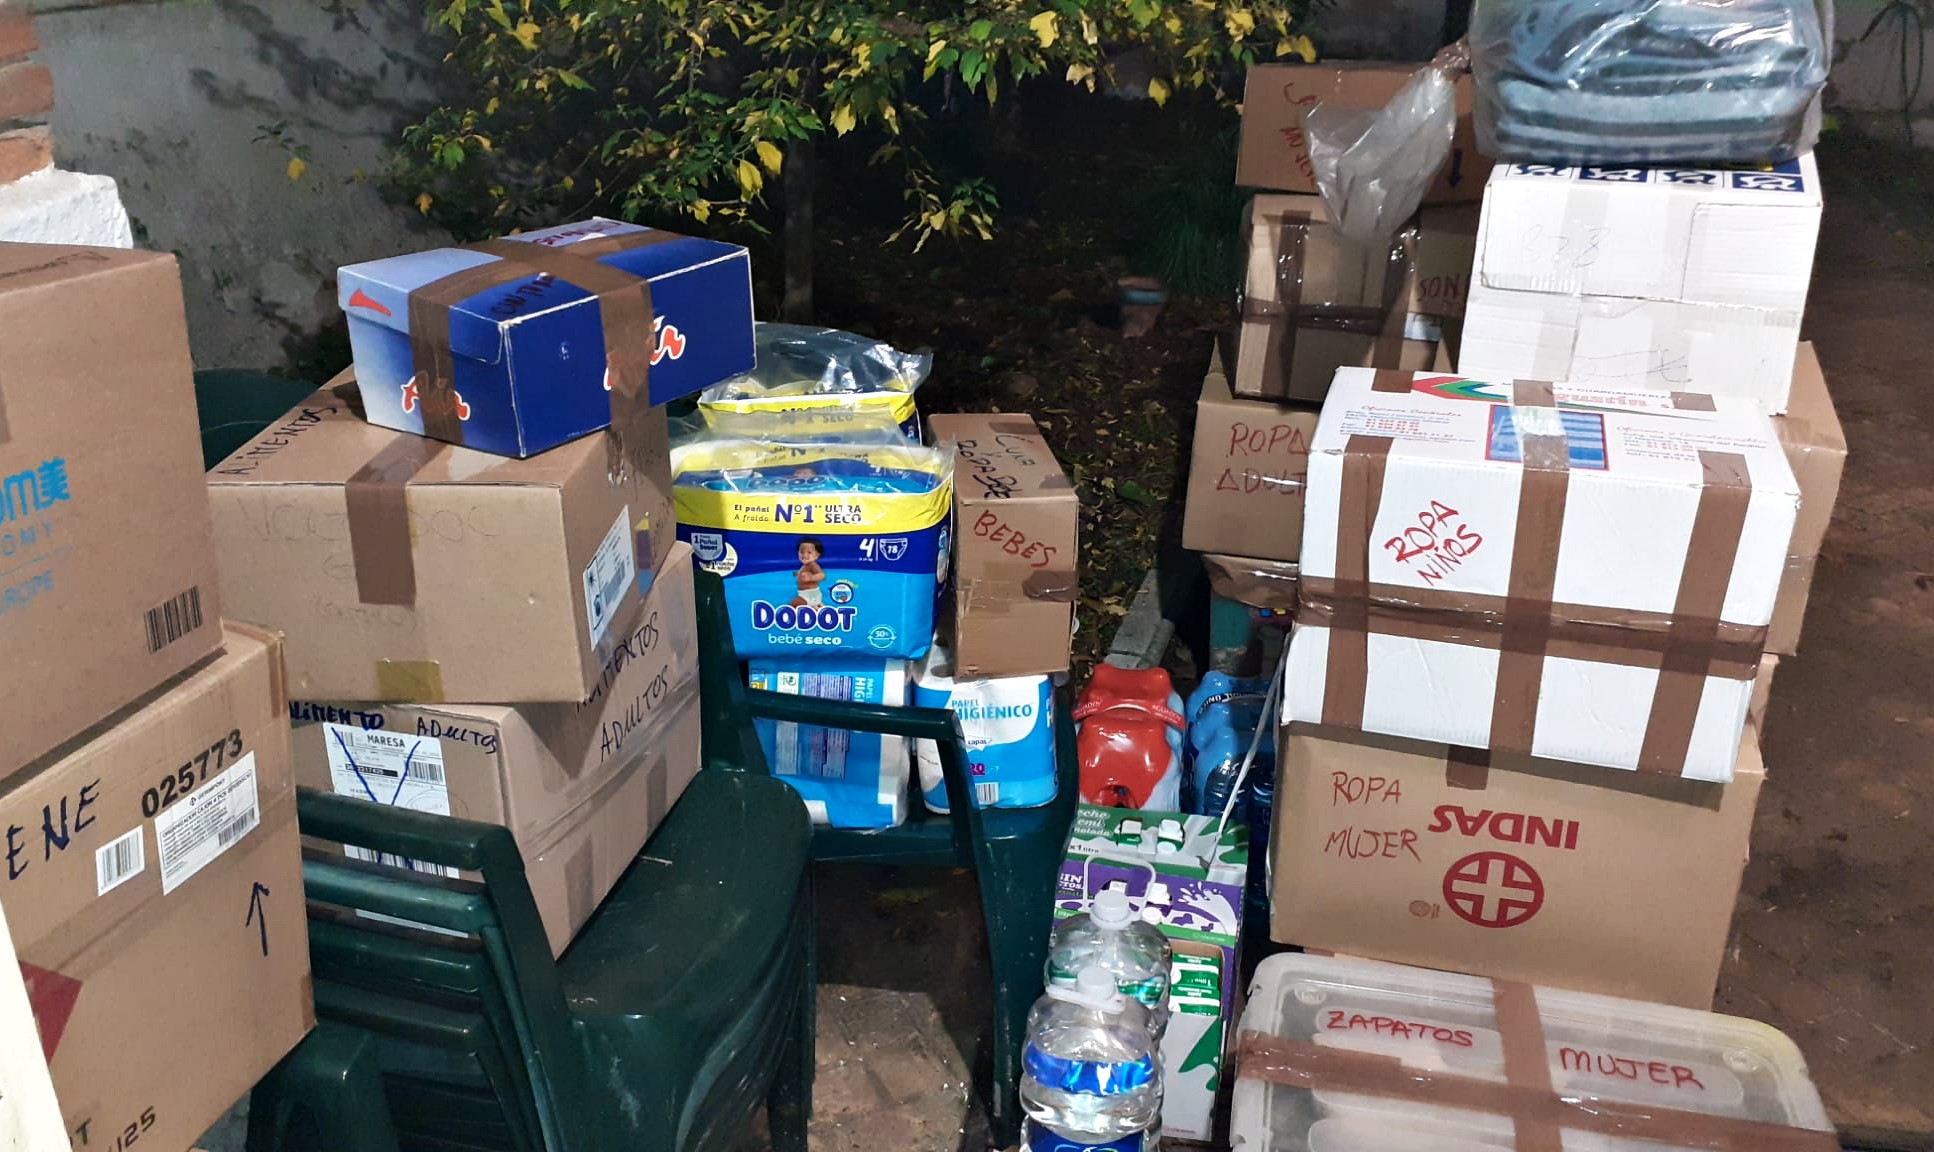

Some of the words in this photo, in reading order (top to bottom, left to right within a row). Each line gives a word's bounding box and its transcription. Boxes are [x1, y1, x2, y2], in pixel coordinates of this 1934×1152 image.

[1227, 422, 1309, 457] ROPA
[825, 504, 862, 514] ULTRA
[825, 514, 862, 524] SECO
[859, 538, 875, 559] 4
[974, 509, 1058, 569] BEBES
[1384, 500, 1459, 563] ROPA
[752, 600, 858, 632] DODOT
[768, 632, 802, 645] bebé
[804, 636, 842, 646] seco
[854, 676, 865, 702] HIG
[951, 698, 979, 707] PAPEL
[601, 665, 669, 763] ADULTOS
[366, 734, 406, 749] MARESA
[141, 728, 244, 819] 025773
[1331, 771, 1402, 805] ROPA
[1324, 826, 1422, 863] MUJER
[1428, 804, 1580, 851] INDAS
[1327, 1009, 1474, 1048] ZAPATOS
[1558, 1045, 1706, 1091] MUJER
